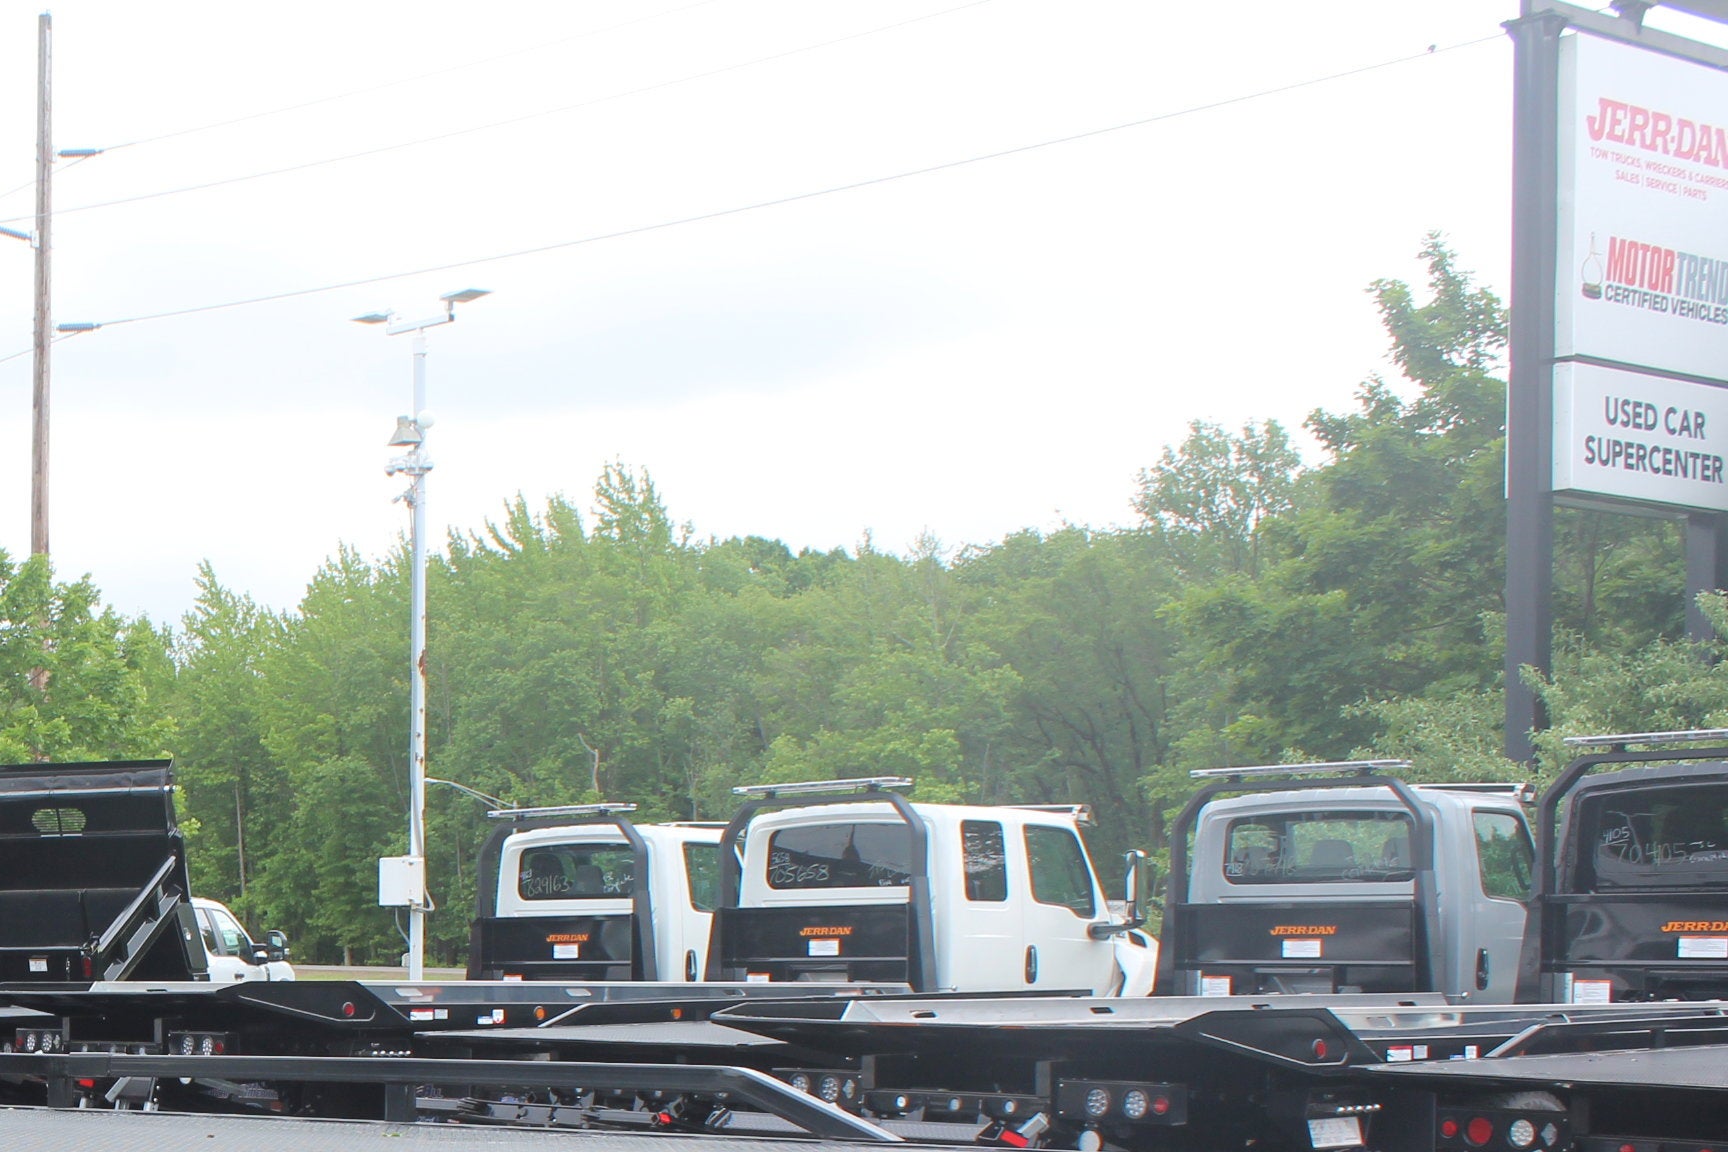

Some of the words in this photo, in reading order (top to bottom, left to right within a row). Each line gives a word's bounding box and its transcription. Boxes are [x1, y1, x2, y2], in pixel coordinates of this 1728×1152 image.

[1615, 169, 1640, 185] SALES
[1646, 176, 1678, 194] SERVICE
[1682, 185, 1707, 201] PARTS
[1604, 284, 1669, 313] CERTIFIED
[1671, 296, 1728, 325] VEHICLES
[1604, 395, 1658, 432] USED
[1664, 406, 1706, 440] CAR
[1584, 434, 1724, 484] SUPERCENTER
